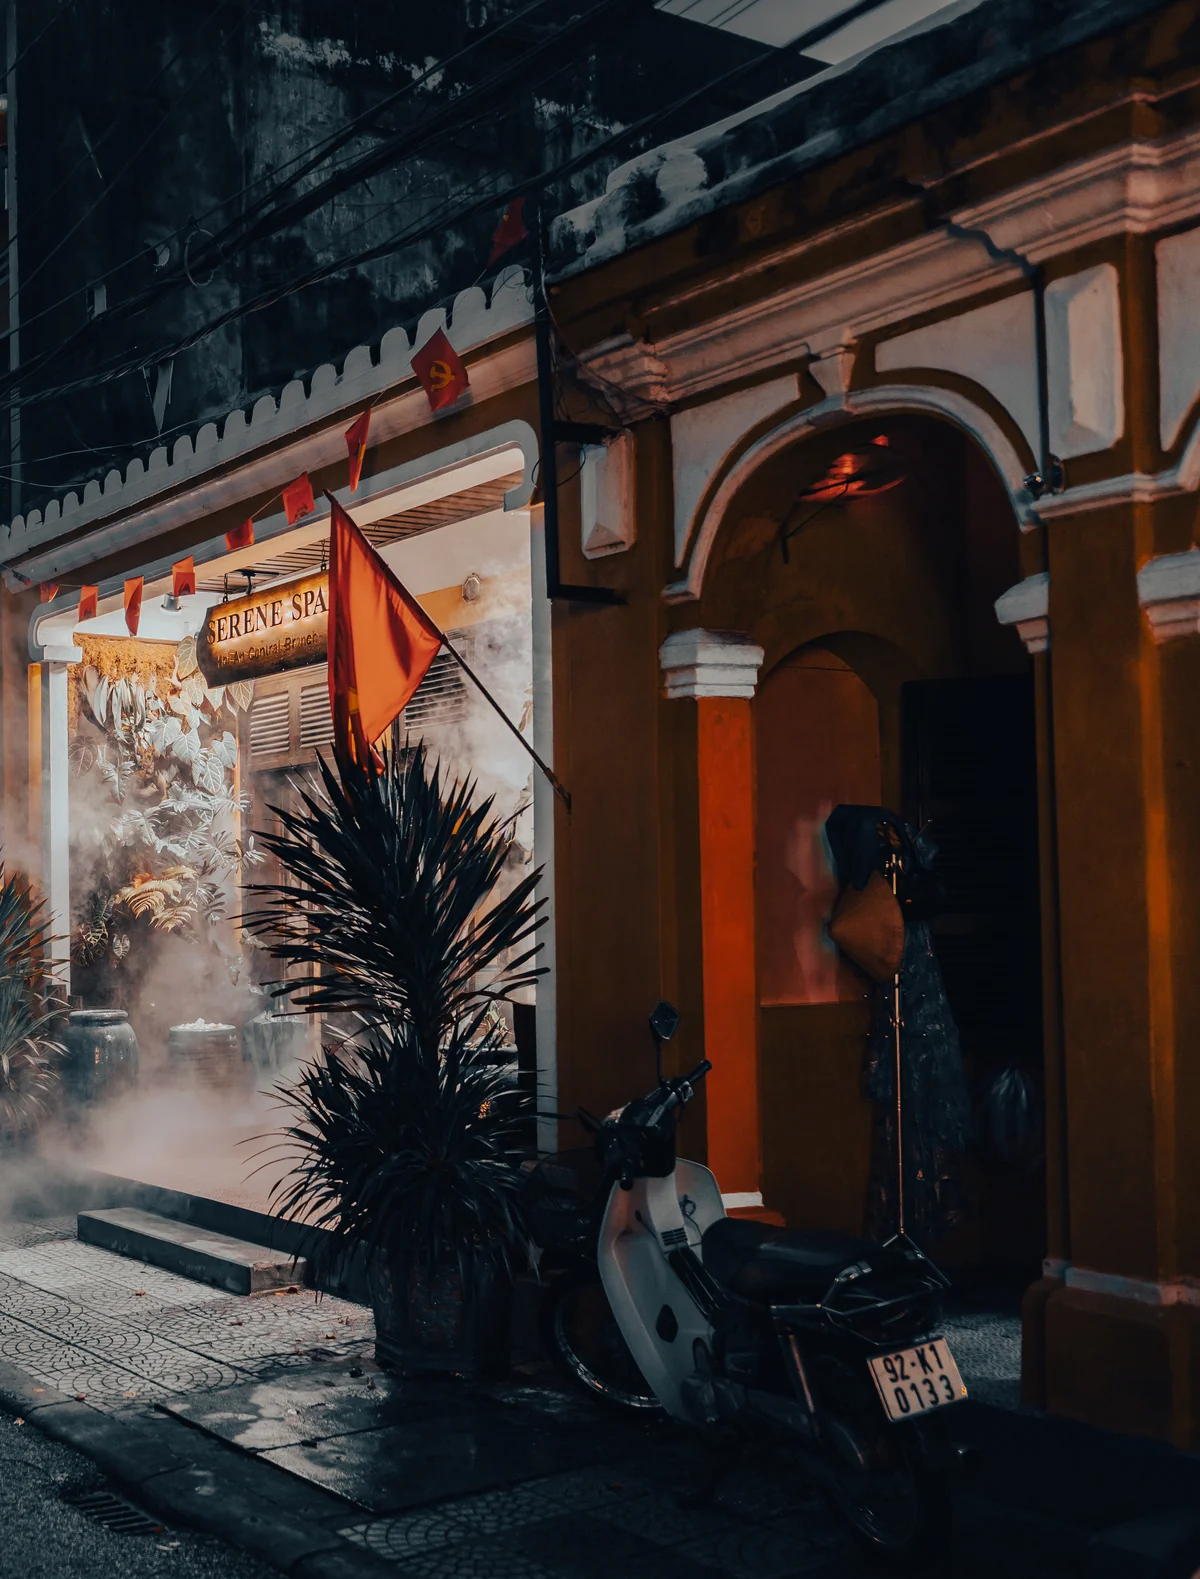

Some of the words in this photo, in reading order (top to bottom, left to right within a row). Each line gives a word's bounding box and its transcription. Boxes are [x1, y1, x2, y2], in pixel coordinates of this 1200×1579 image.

[207, 600, 283, 644] SERENE
[292, 586, 329, 621] SPA
[883, 1344, 943, 1382] 92-K1
[894, 1374, 955, 1413] 0133
